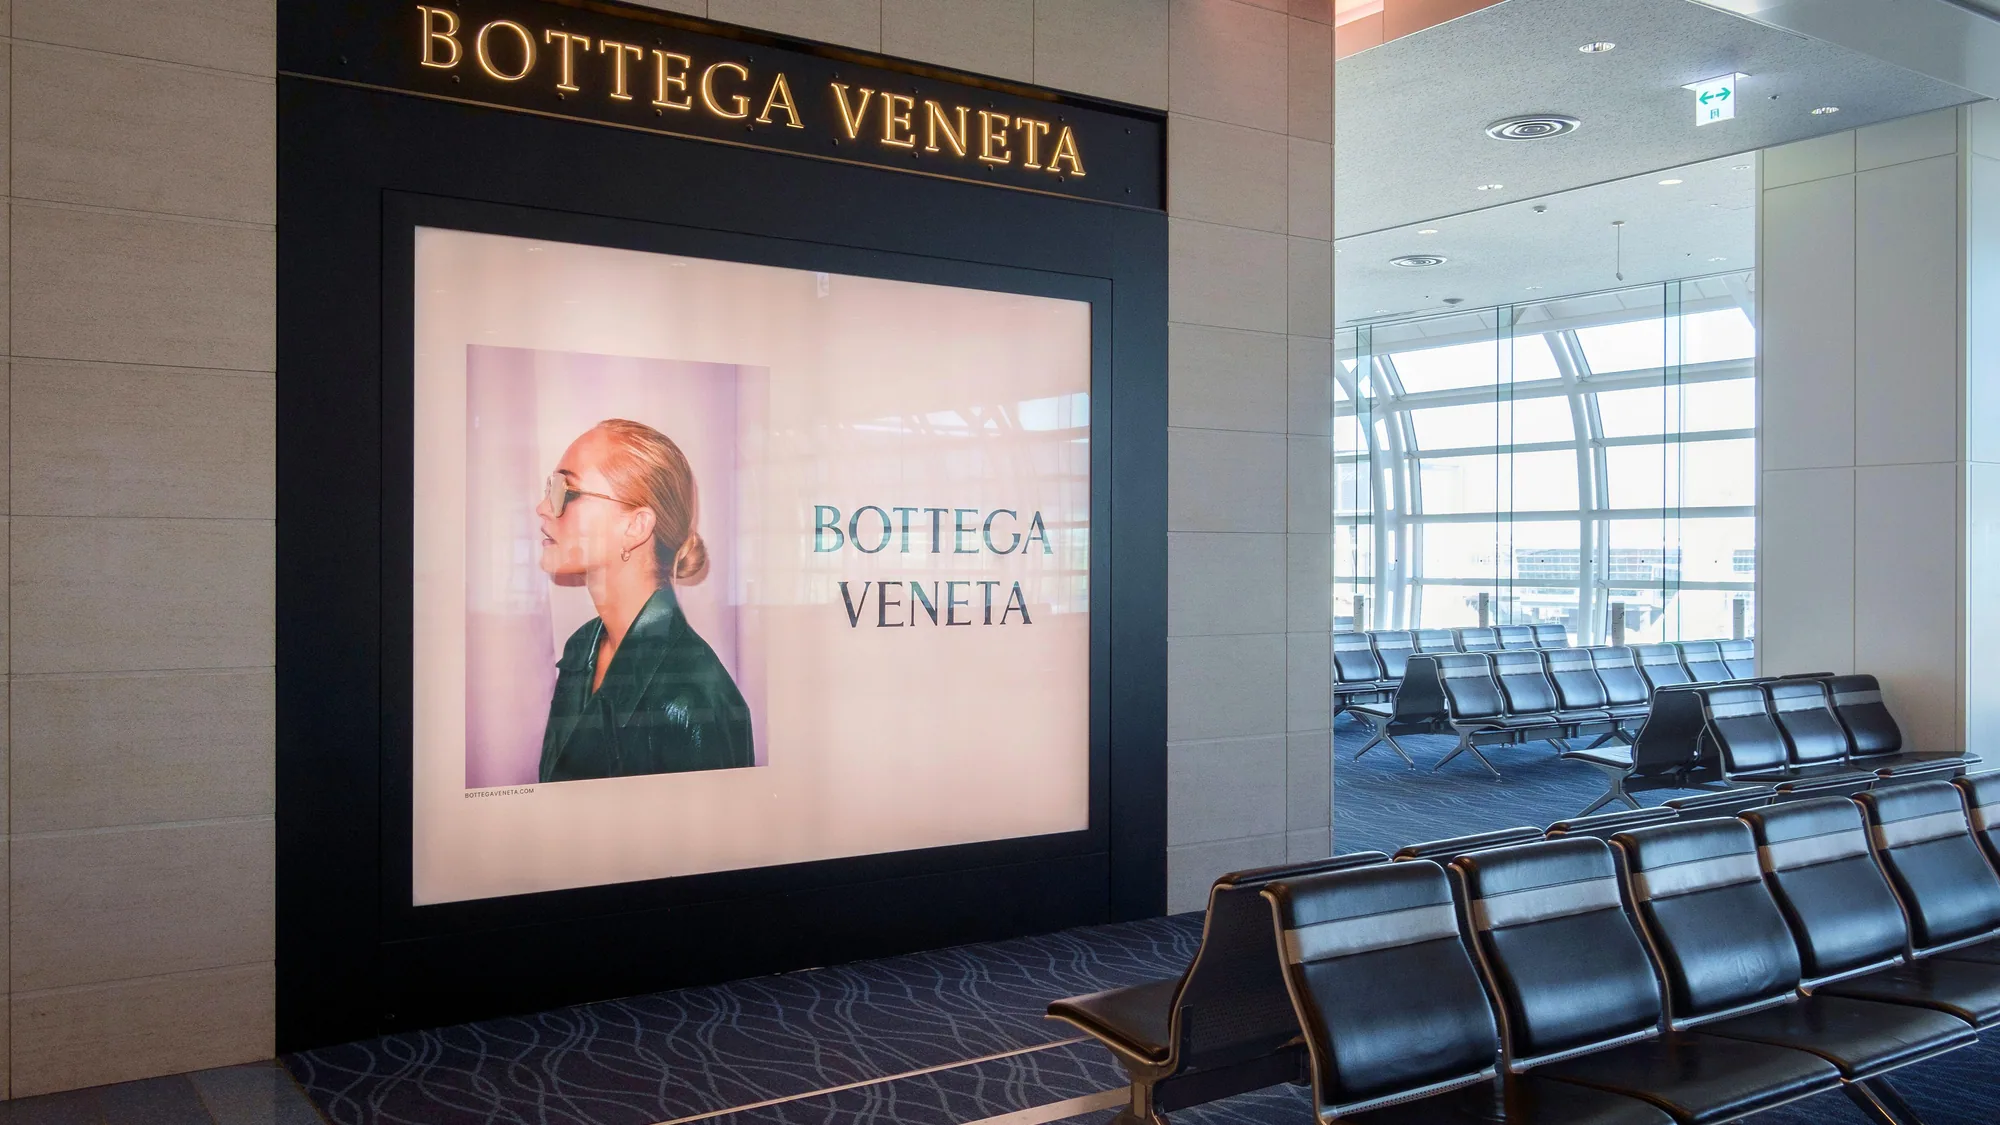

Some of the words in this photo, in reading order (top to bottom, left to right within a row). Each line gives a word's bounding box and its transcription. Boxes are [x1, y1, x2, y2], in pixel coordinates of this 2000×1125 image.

[417, 5, 804, 129] BOTTEGA
[830, 82, 1087, 177] VENETA
[813, 505, 1053, 555] BOTTEGA
[837, 580, 1032, 628] VENETA
[464, 788, 534, 798] BOTTEGAVENETA.COM
